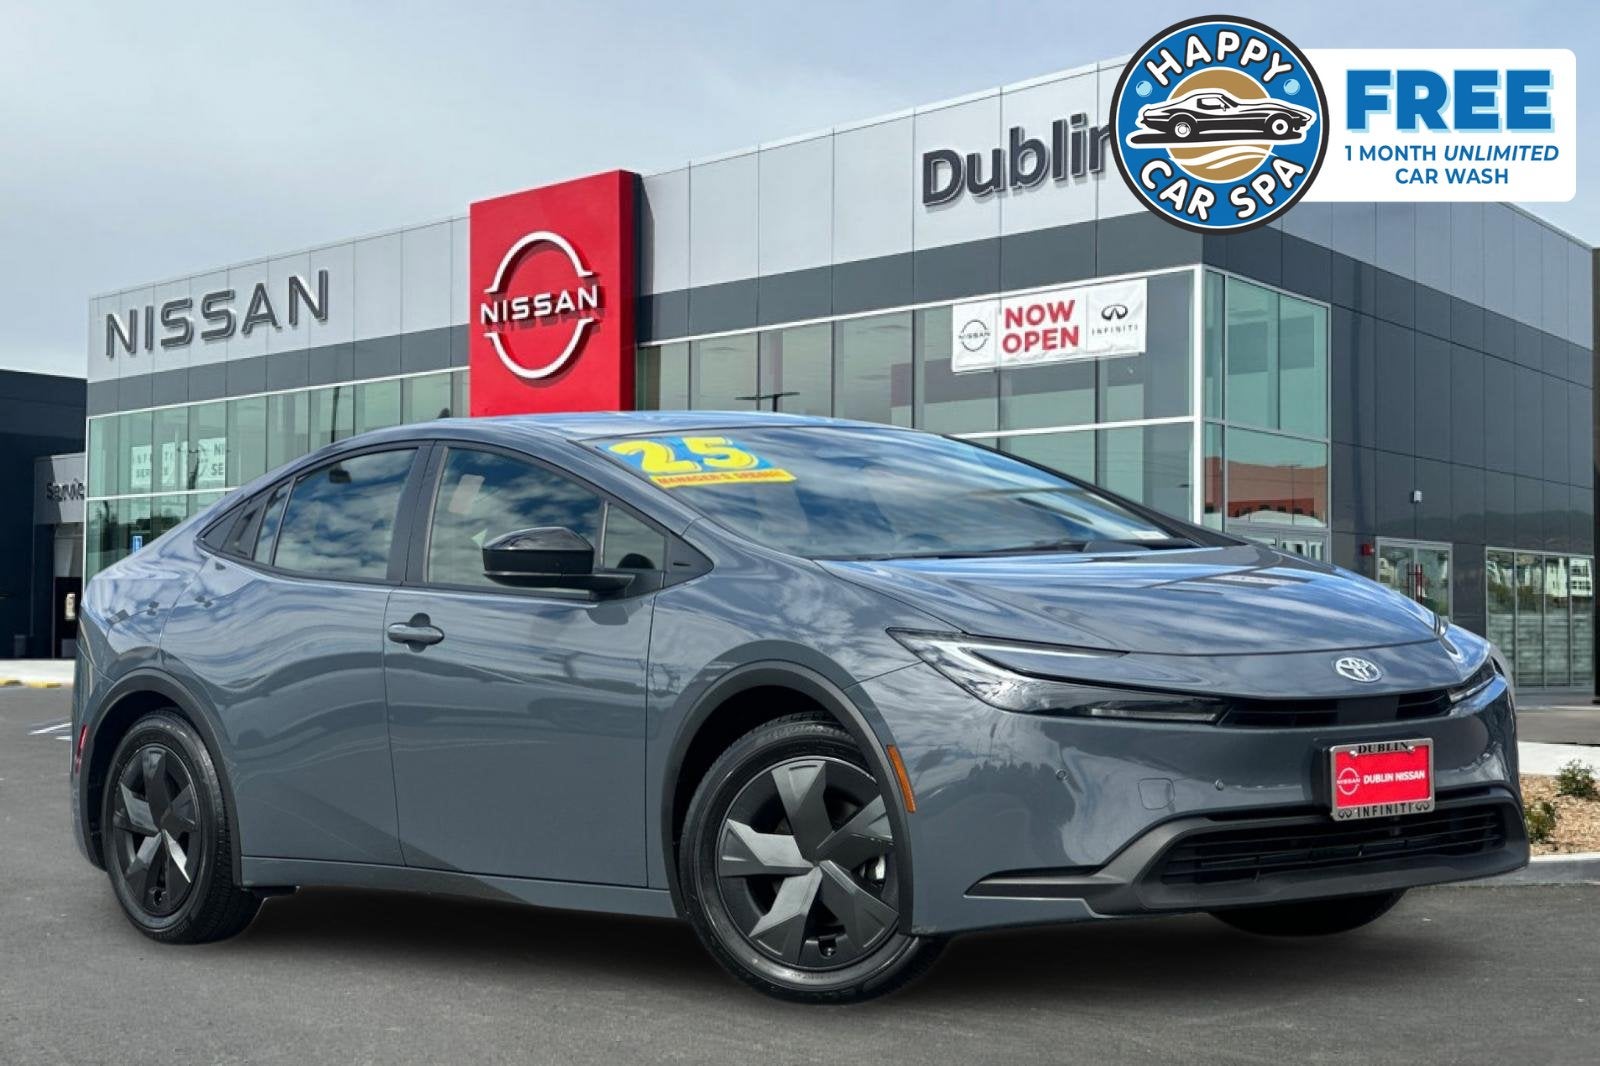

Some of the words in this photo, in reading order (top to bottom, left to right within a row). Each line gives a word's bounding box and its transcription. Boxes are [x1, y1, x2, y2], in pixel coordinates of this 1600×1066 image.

[106, 269, 329, 358] NISSAN
[480, 285, 599, 324] NISSAN
[1005, 300, 1076, 328] NOW
[958, 331, 991, 341] NISSAN
[1002, 325, 1080, 354] OPEN
[1091, 324, 1139, 336] INFINITI
[608, 436, 759, 473] 25
[1358, 741, 1409, 754] DUBLIN
[1363, 772, 1394, 785] DUBLIN
[1395, 770, 1425, 782] NISSAN
[1357, 803, 1412, 818] INFINITI
